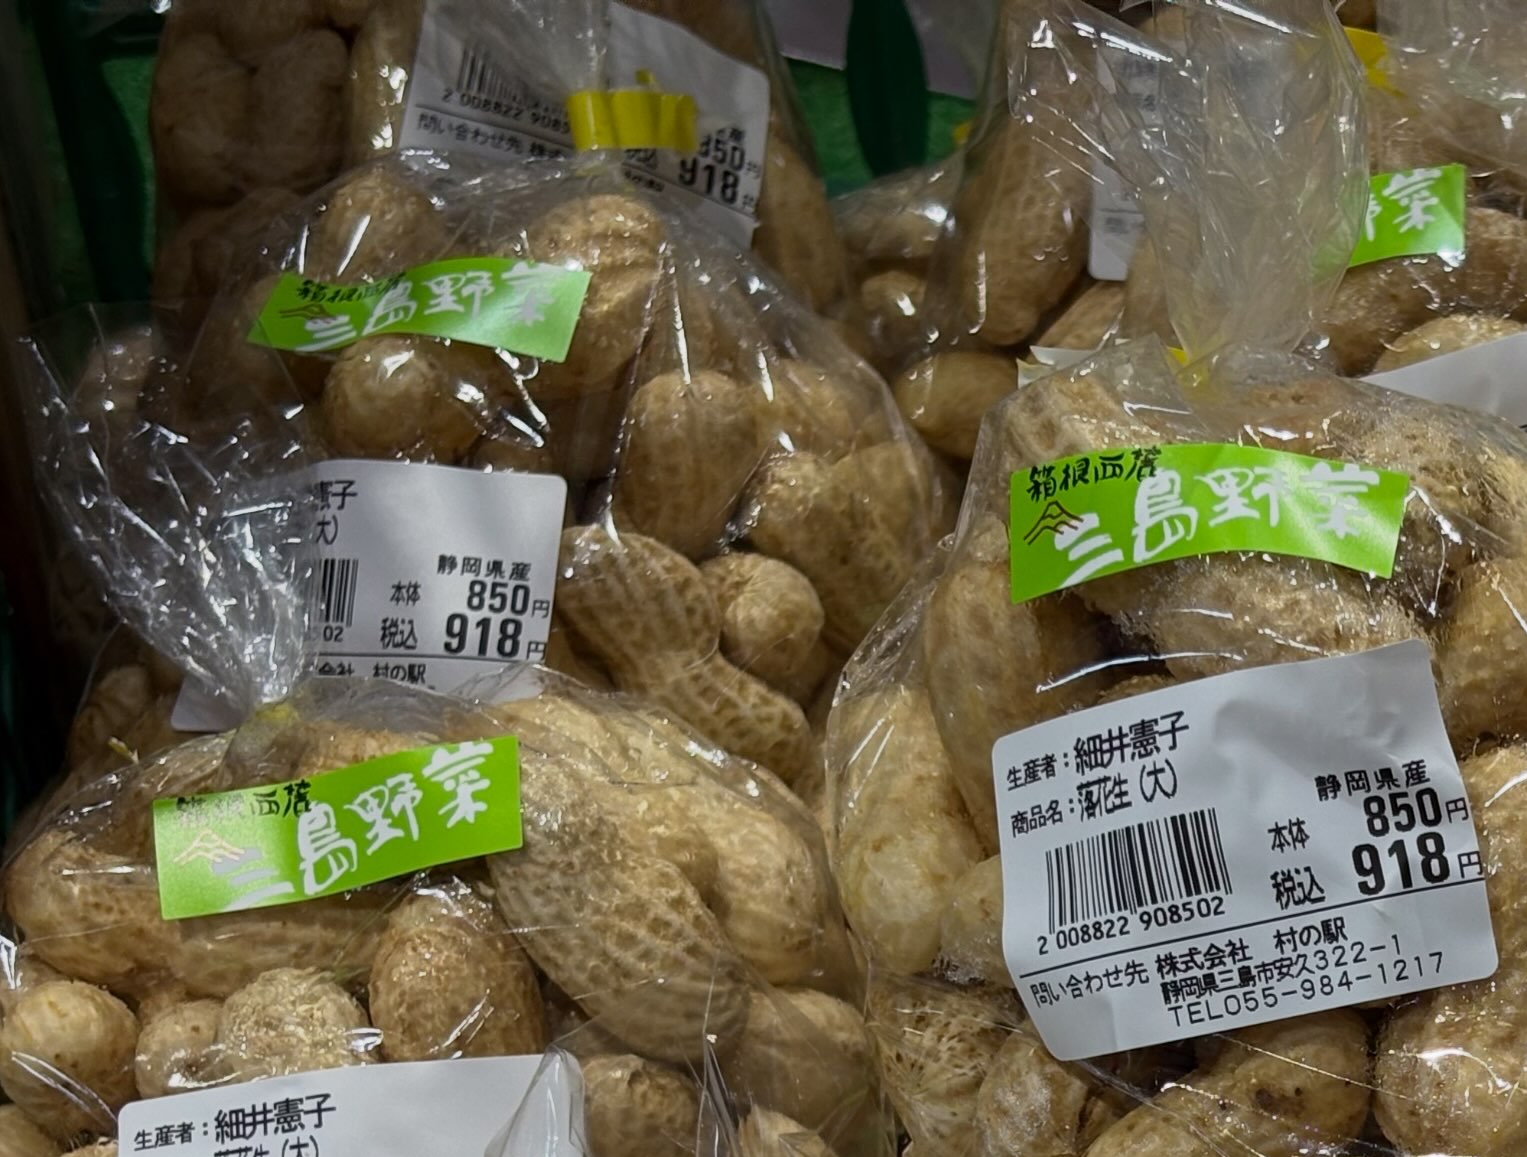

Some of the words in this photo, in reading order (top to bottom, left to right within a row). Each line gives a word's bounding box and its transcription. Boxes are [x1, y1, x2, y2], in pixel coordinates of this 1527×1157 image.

[1054, 461, 1380, 589] 三島野菜
[391, 581, 421, 607] 本体
[467, 579, 550, 620] 850円
[437, 553, 531, 582] 静岡県産
[380, 617, 418, 651] 税込
[444, 612, 546, 662] 918円
[1315, 759, 1431, 801] 静岡県産
[210, 741, 493, 912] 三島野菜
[1268, 817, 1310, 852] 本体
[1363, 787, 1469, 839] 850円
[1270, 866, 1325, 909] 税込
[1352, 830, 1483, 895] 918円
[1038, 936, 1048, 955] 2
[1056, 916, 1131, 950] 008822
[1140, 896, 1226, 931] 908502
[1030, 959, 1150, 1008] 問い合わせ先
[1156, 939, 1252, 978] 株式会社
[1273, 917, 1347, 952] 村の駅
[1168, 951, 1444, 1027] TEL055-984-1217
